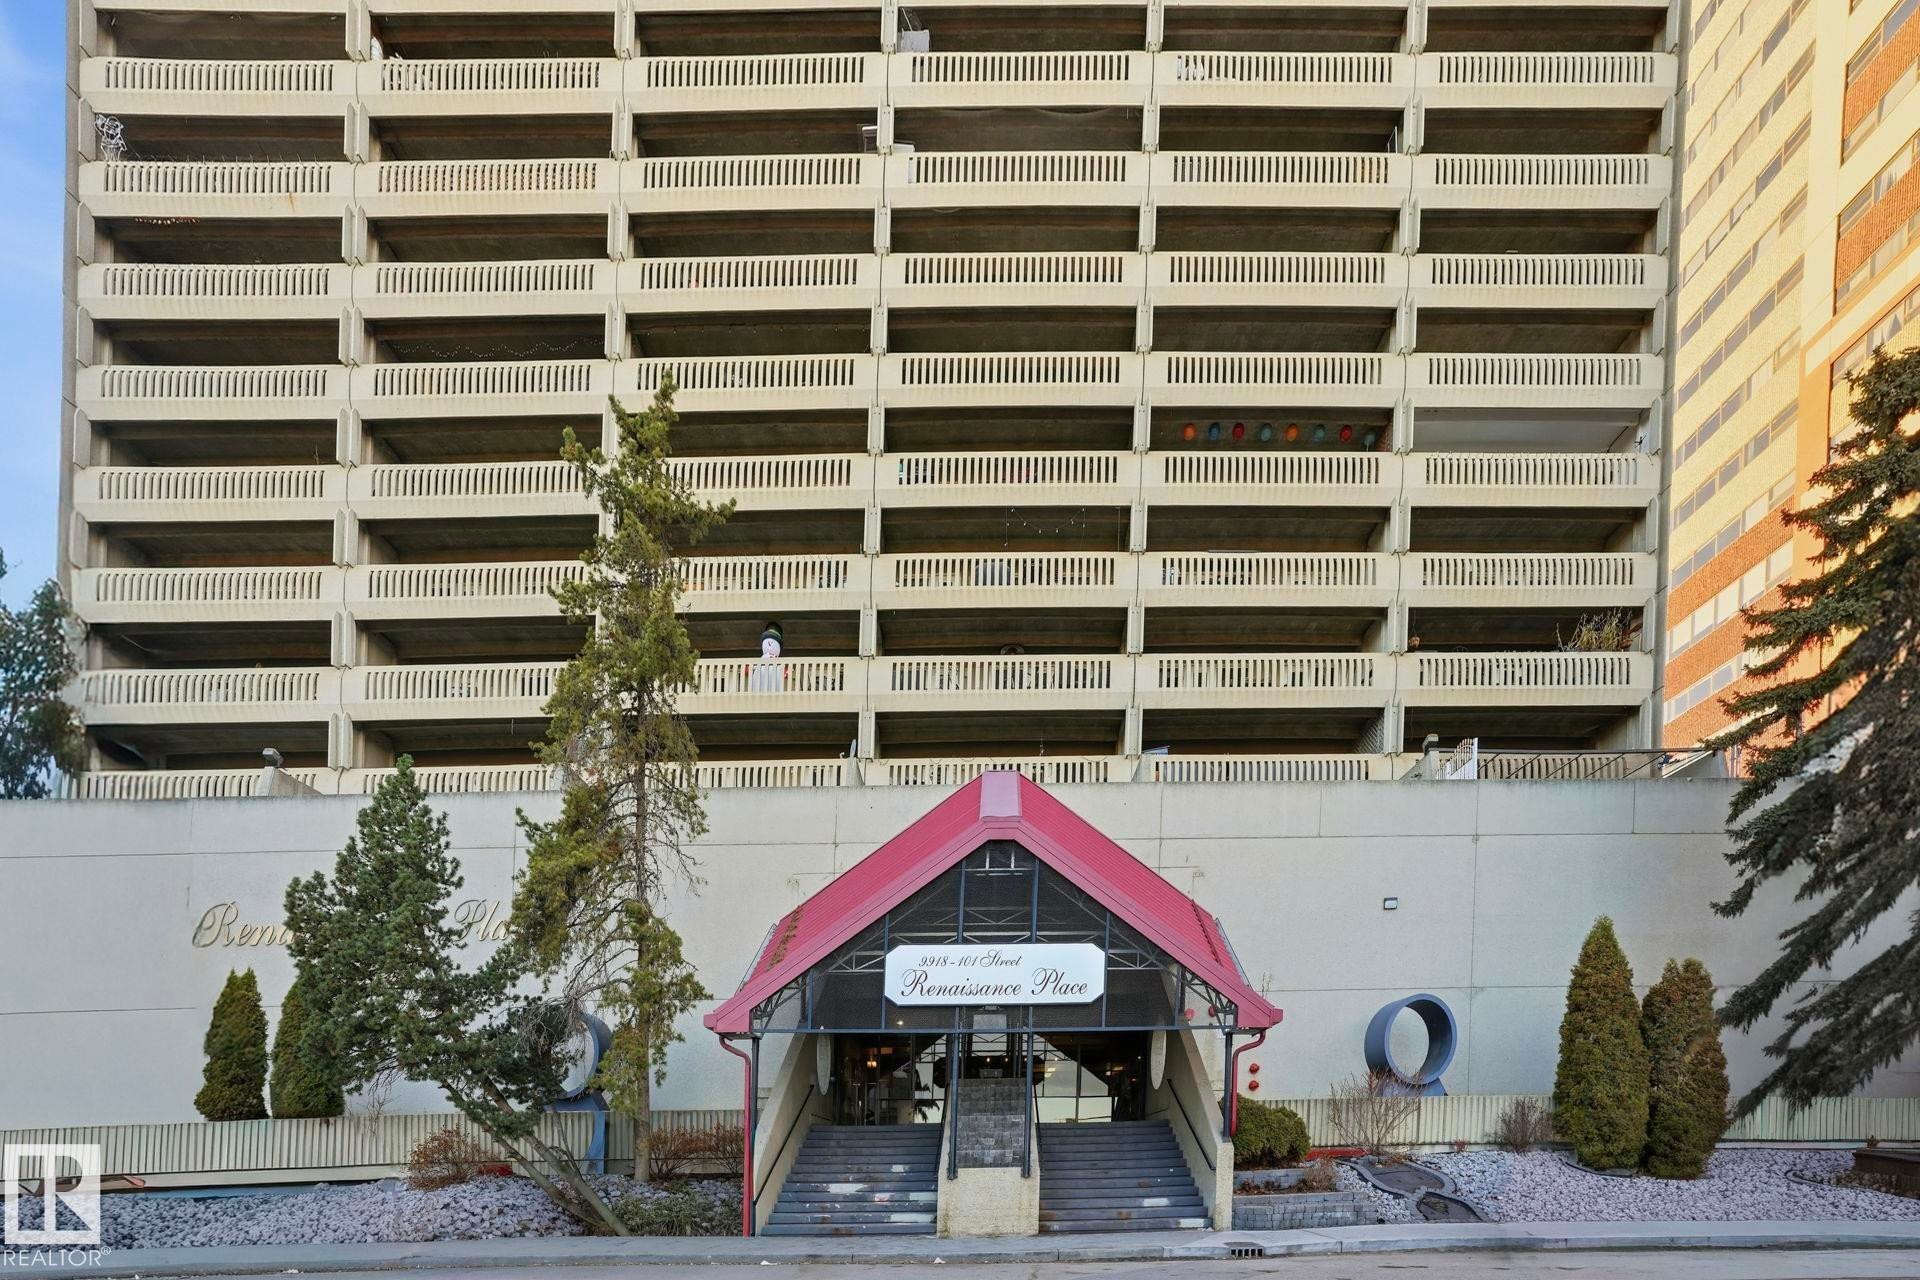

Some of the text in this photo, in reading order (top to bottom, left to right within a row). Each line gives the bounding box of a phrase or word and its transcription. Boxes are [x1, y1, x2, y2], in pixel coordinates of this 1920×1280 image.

[453, 898, 513, 942] Pla
[980, 949, 1022, 968] Street
[901, 967, 1088, 997] Renaissance Place
